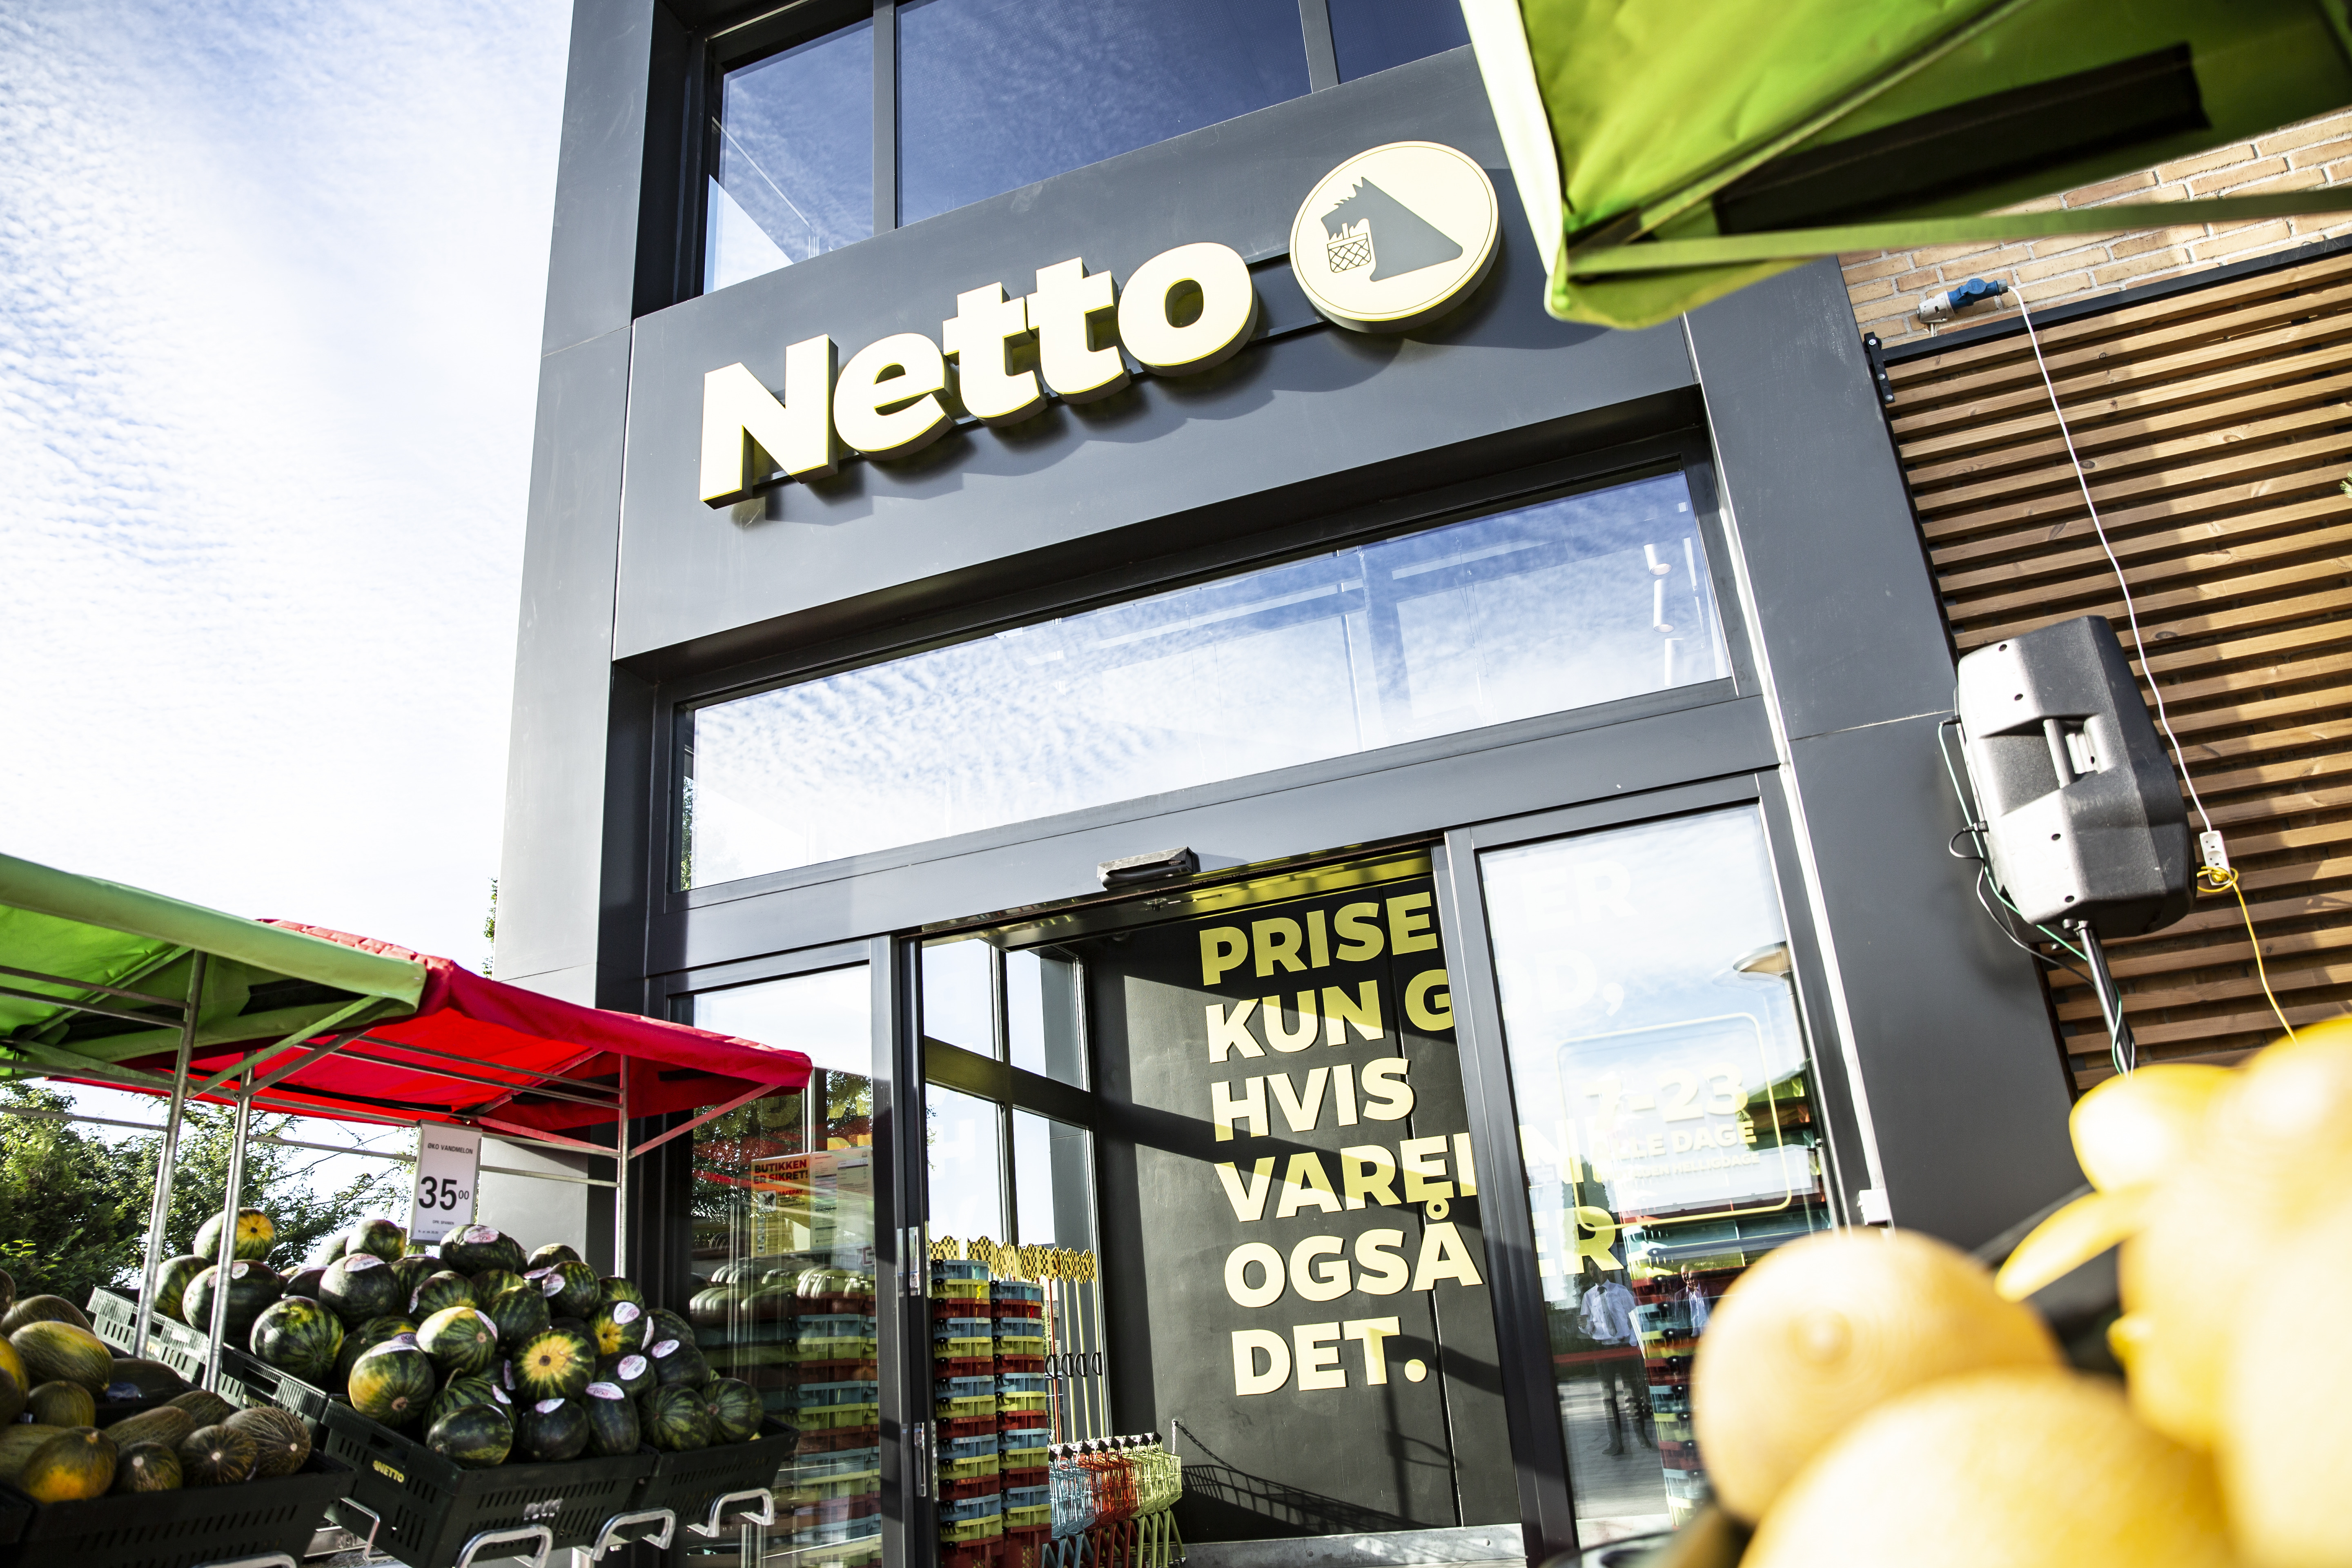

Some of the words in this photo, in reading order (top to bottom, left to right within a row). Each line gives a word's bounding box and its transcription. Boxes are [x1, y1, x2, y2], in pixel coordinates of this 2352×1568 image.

[699, 242, 1258, 510] Netto
[1200, 880, 1501, 986] PRISE
[1205, 979, 1384, 1062] KUN
[1209, 1057, 1415, 1141] HVIS
[441, 1145, 473, 1154] VANDMELON
[1670, 1120, 1757, 1153] DAGE
[1671, 1152, 1760, 1174] HELLIGDAGE
[419, 1176, 457, 1210] 35
[753, 1175, 766, 1184] ER
[768, 1170, 808, 1182] SIKRET!
[754, 1159, 807, 1173] BUTIKKEN
[1225, 1196, 1482, 1308] OGSÅ
[1232, 1316, 1428, 1396] DET.
